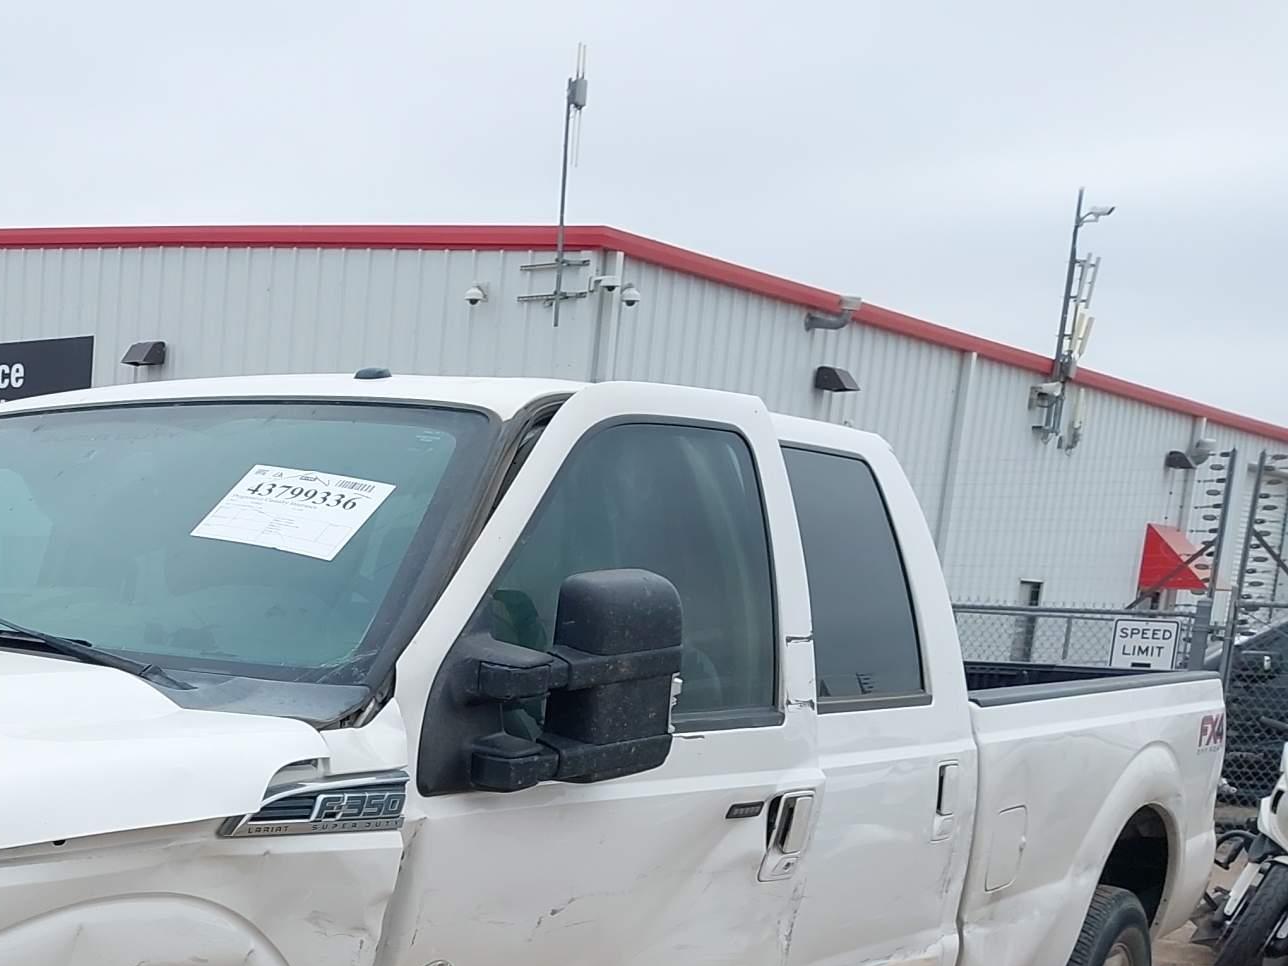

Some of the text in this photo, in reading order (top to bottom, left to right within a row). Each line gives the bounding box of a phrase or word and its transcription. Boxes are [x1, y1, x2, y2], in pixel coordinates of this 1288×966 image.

[247, 481, 358, 511] 43799336
[1119, 627, 1173, 641] SPEED
[1122, 645, 1165, 658] LIMIT
[1199, 713, 1224, 747] FX4
[247, 825, 290, 834] LARIAT
[311, 822, 358, 831] SUPER
